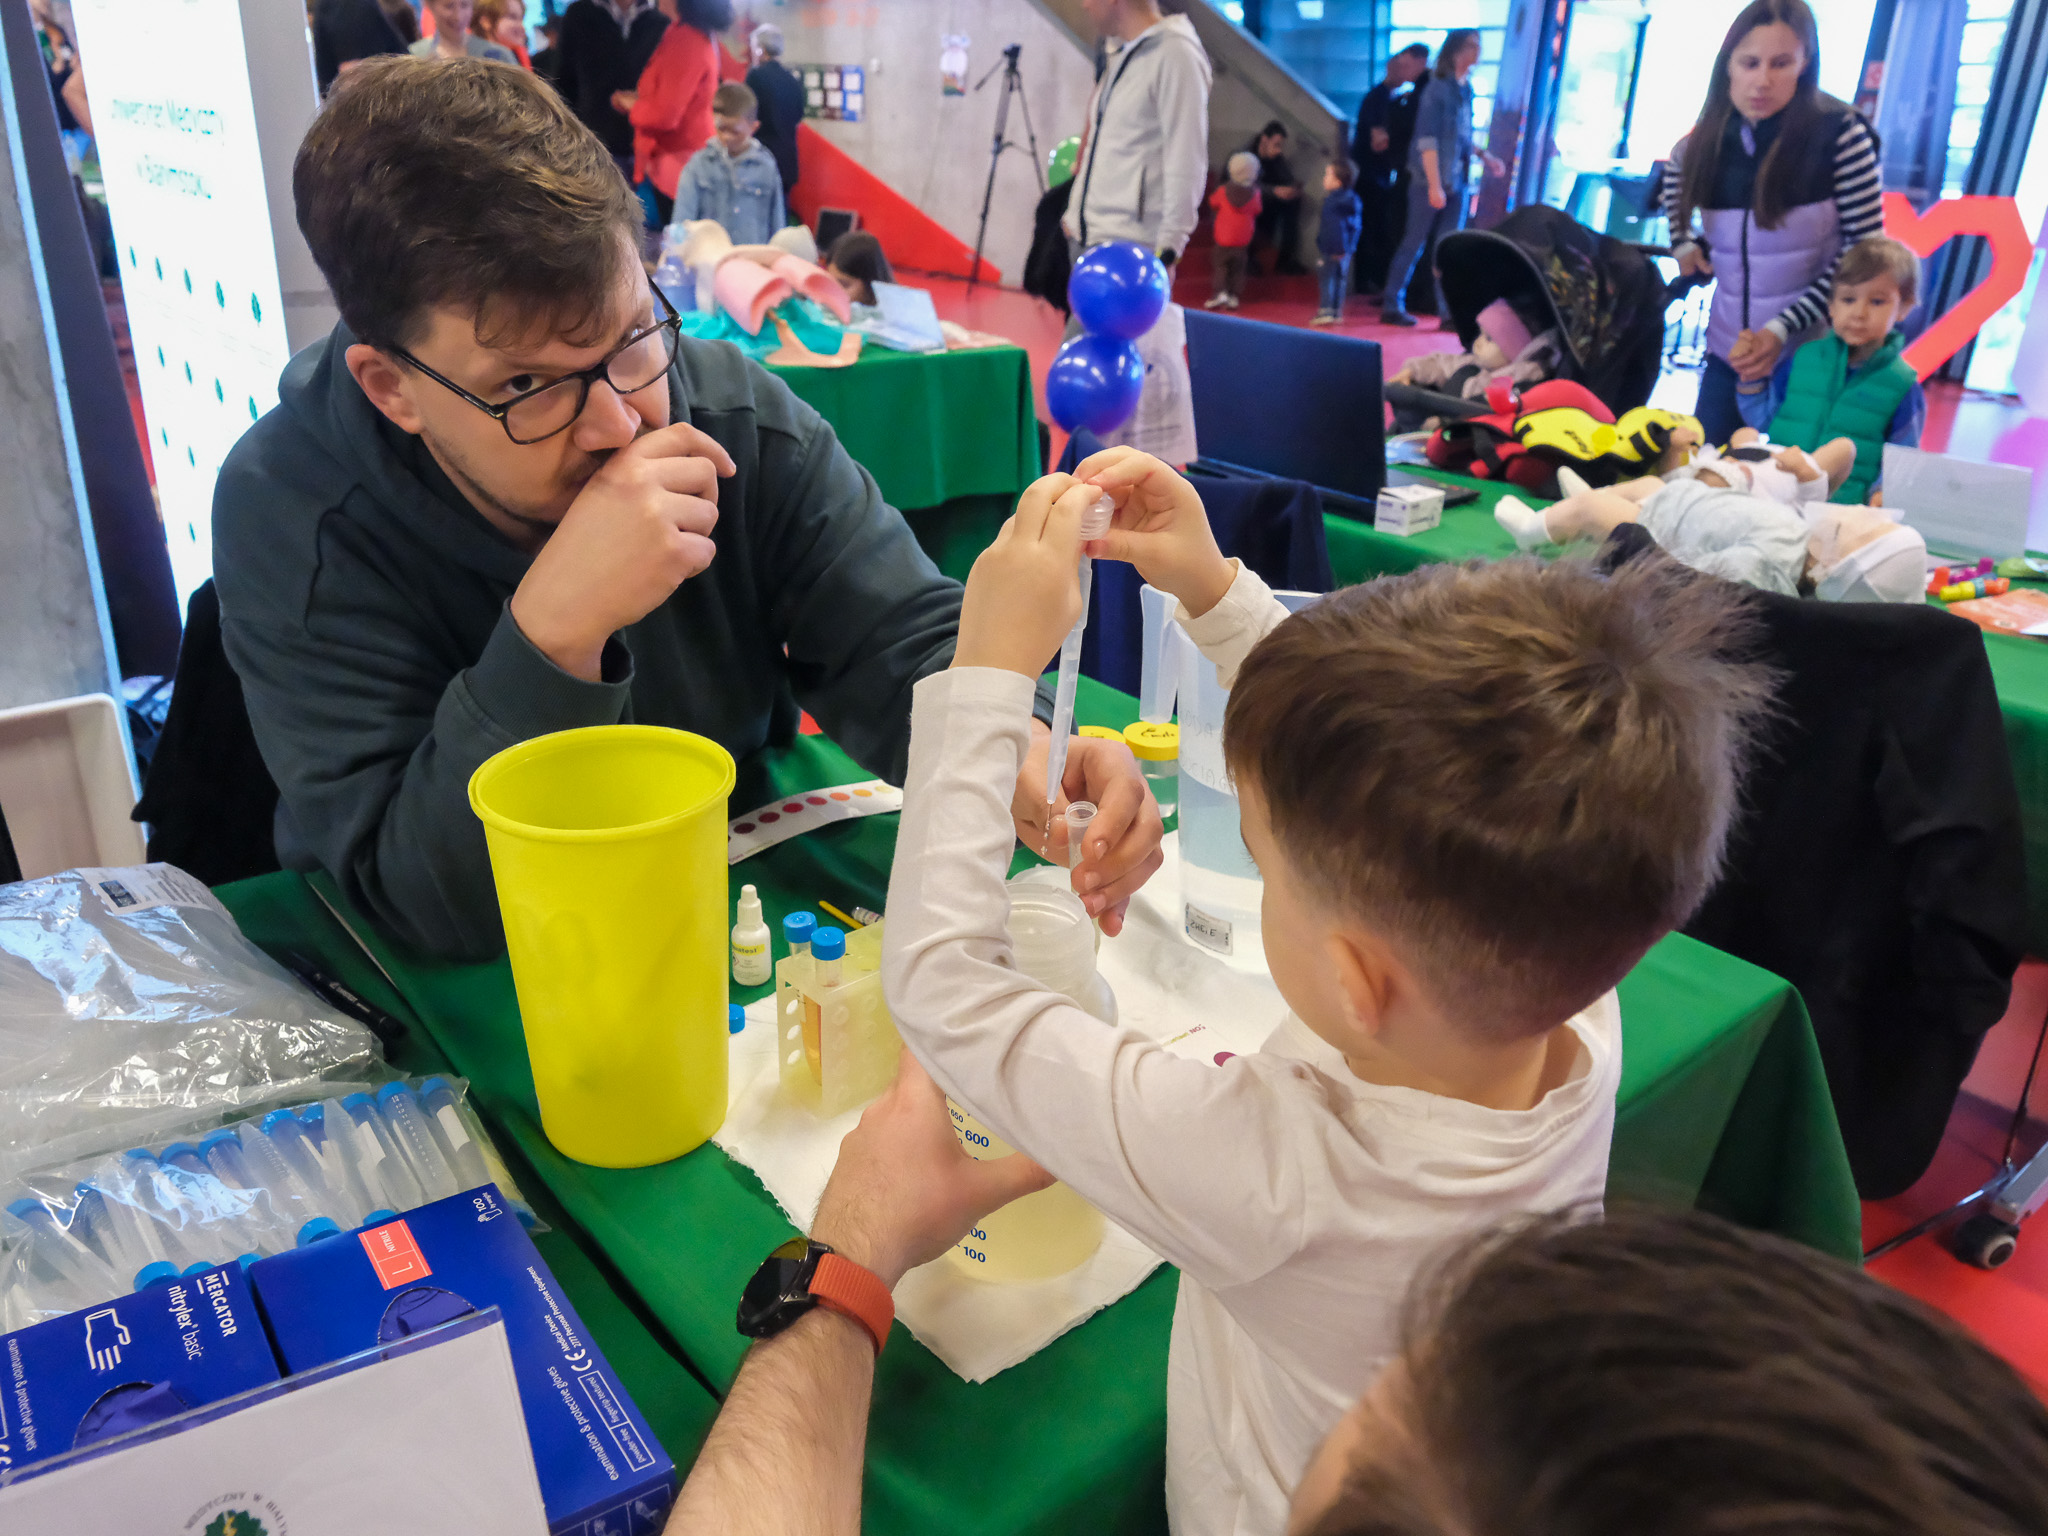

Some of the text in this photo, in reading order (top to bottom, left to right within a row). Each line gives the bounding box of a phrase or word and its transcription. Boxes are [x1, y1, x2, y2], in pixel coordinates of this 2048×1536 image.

[965, 1129, 990, 1148] 600
[472, 1197, 487, 1213] 100
[378, 1229, 397, 1253] NITRILE
[968, 1227, 987, 1241] 00
[963, 1246, 986, 1263] 100
[391, 1261, 413, 1275] L
[526, 1265, 547, 1292] Equipment
[203, 1273, 238, 1337] MERCATOR
[542, 1290, 561, 1316] Protective
[544, 1314, 571, 1352] Medical Device
[555, 1313, 574, 1337] Personal
[182, 1329, 204, 1361] basic
[8, 1338, 38, 1452] examination & protective gloves
[546, 1366, 619, 1481] examination & protective gloves
[586, 1376, 647, 1463] powder-free fingertip textured
